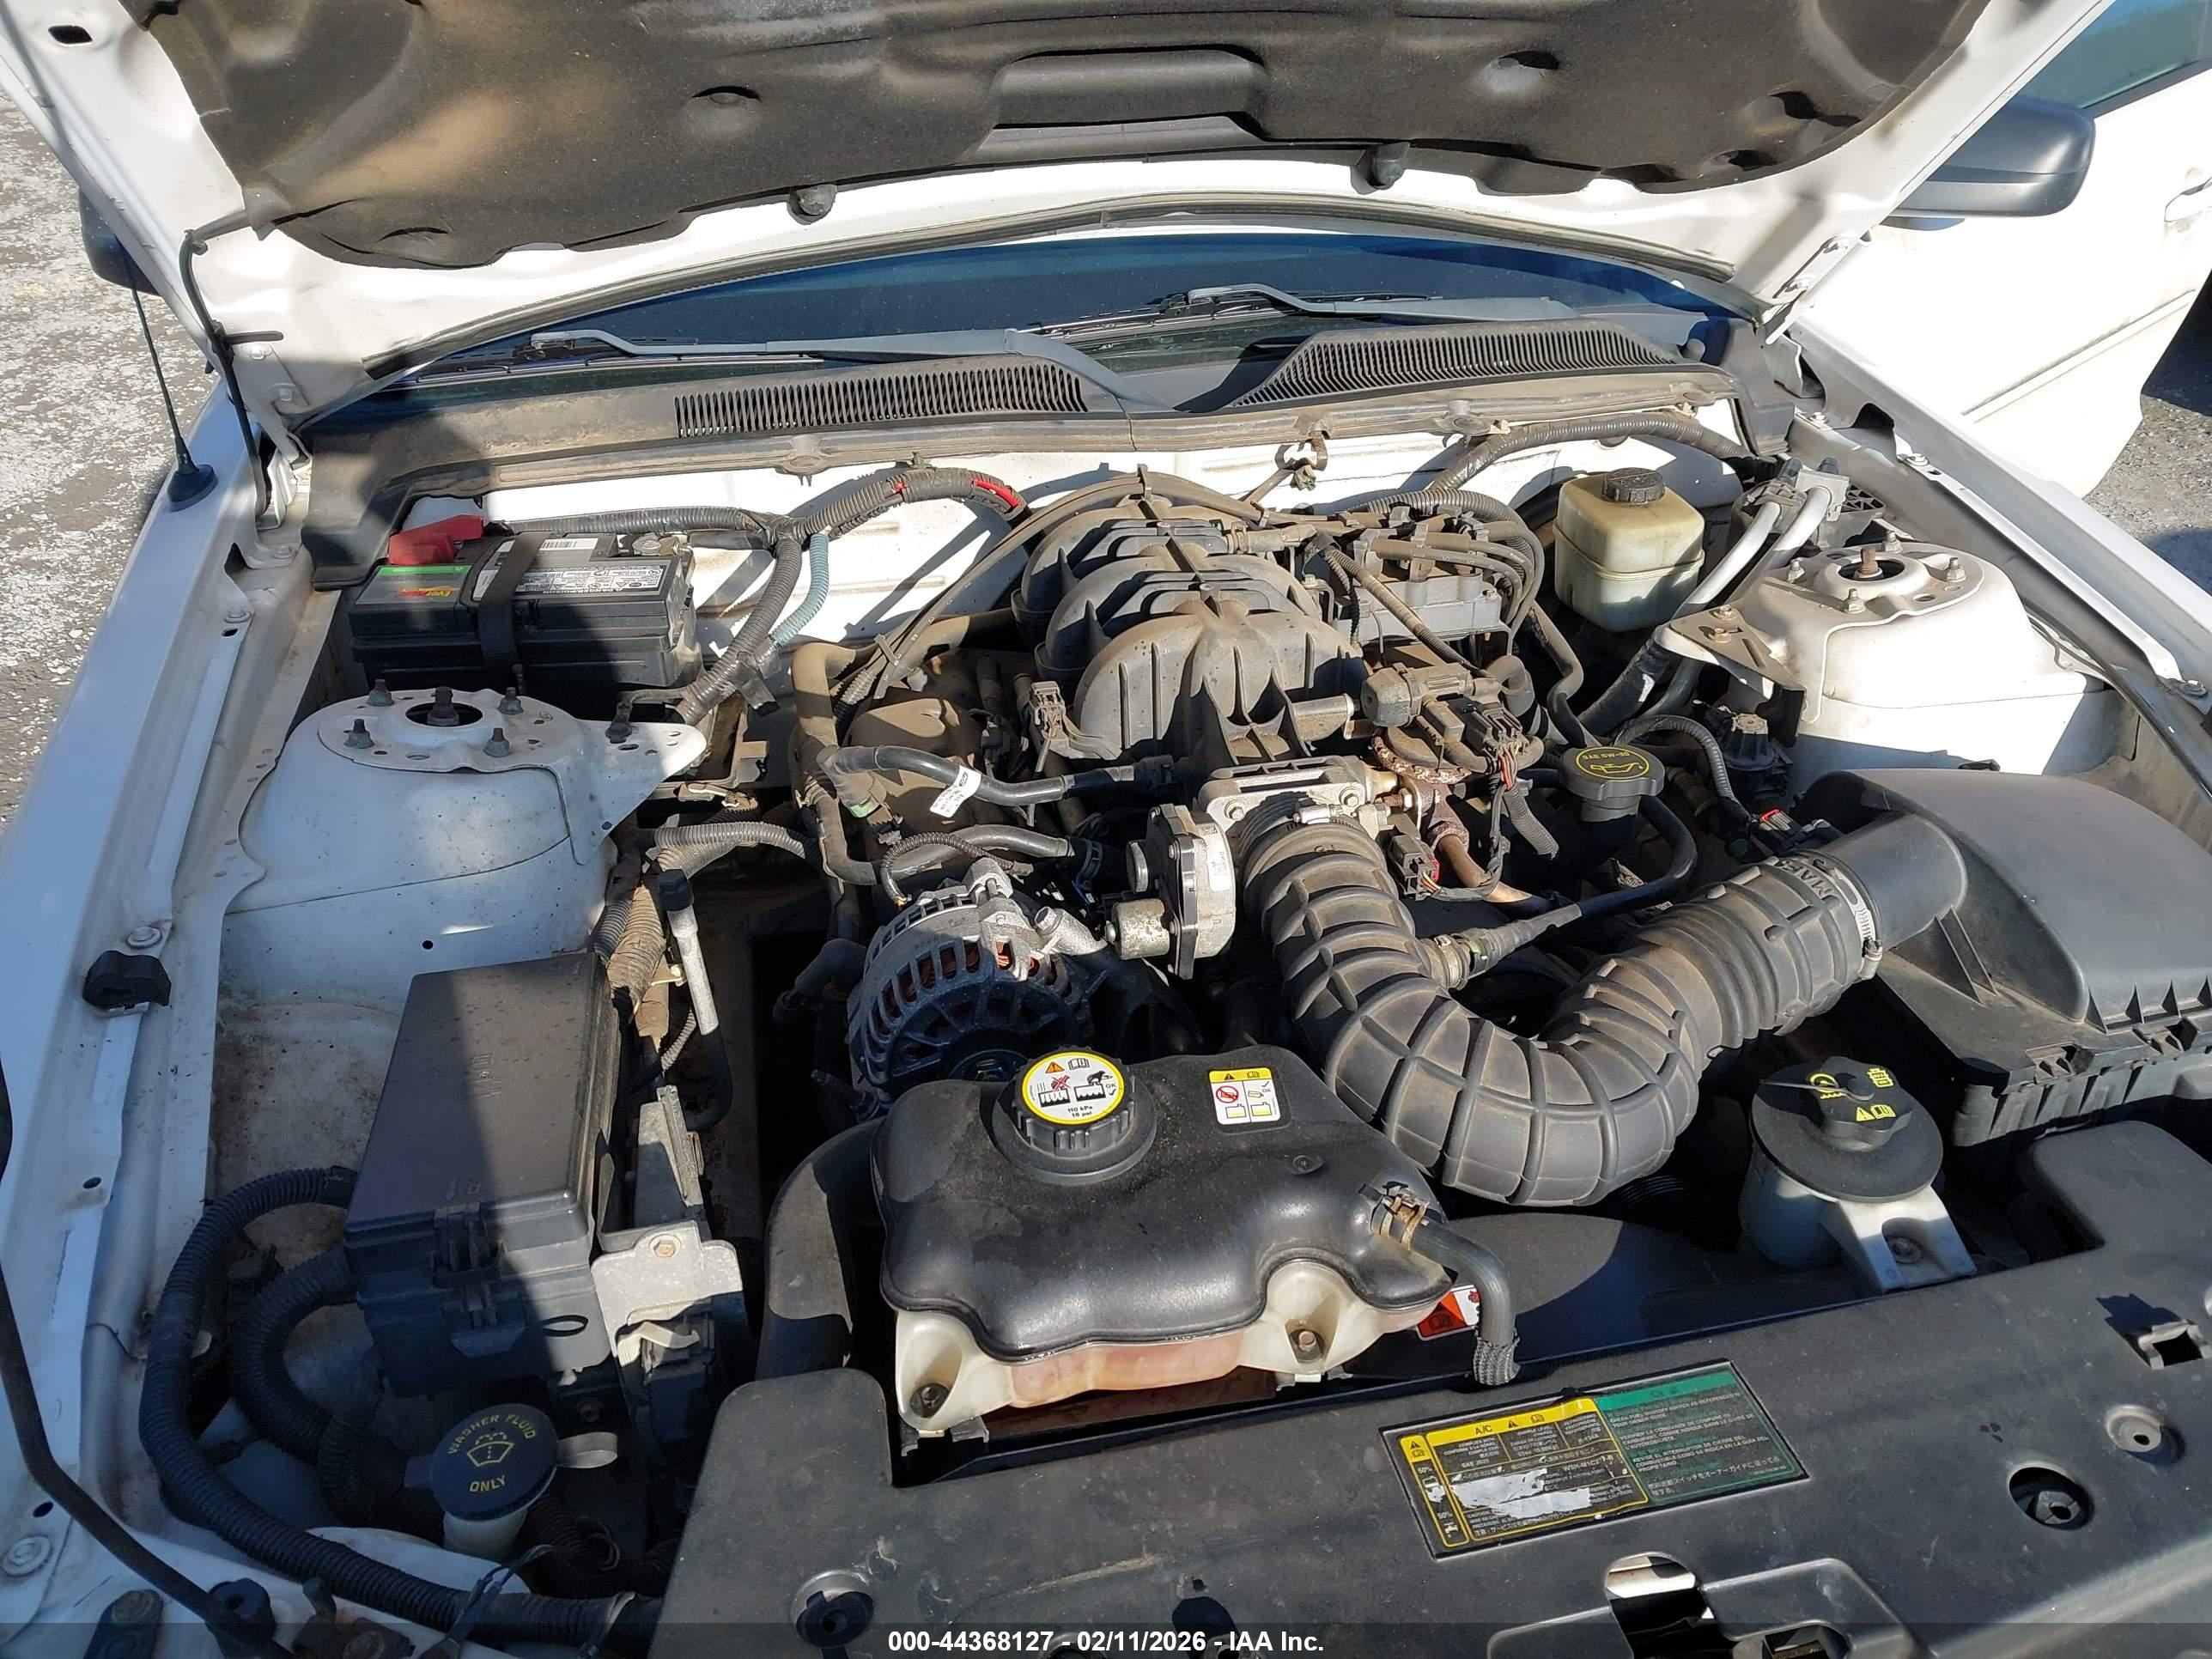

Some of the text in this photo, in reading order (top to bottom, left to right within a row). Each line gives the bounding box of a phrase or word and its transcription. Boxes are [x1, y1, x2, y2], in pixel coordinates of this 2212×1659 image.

[447, 1413, 536, 1455] WASHER FLUID
[1475, 1425, 1492, 1435] A/C
[469, 1474, 506, 1492] ONLY
